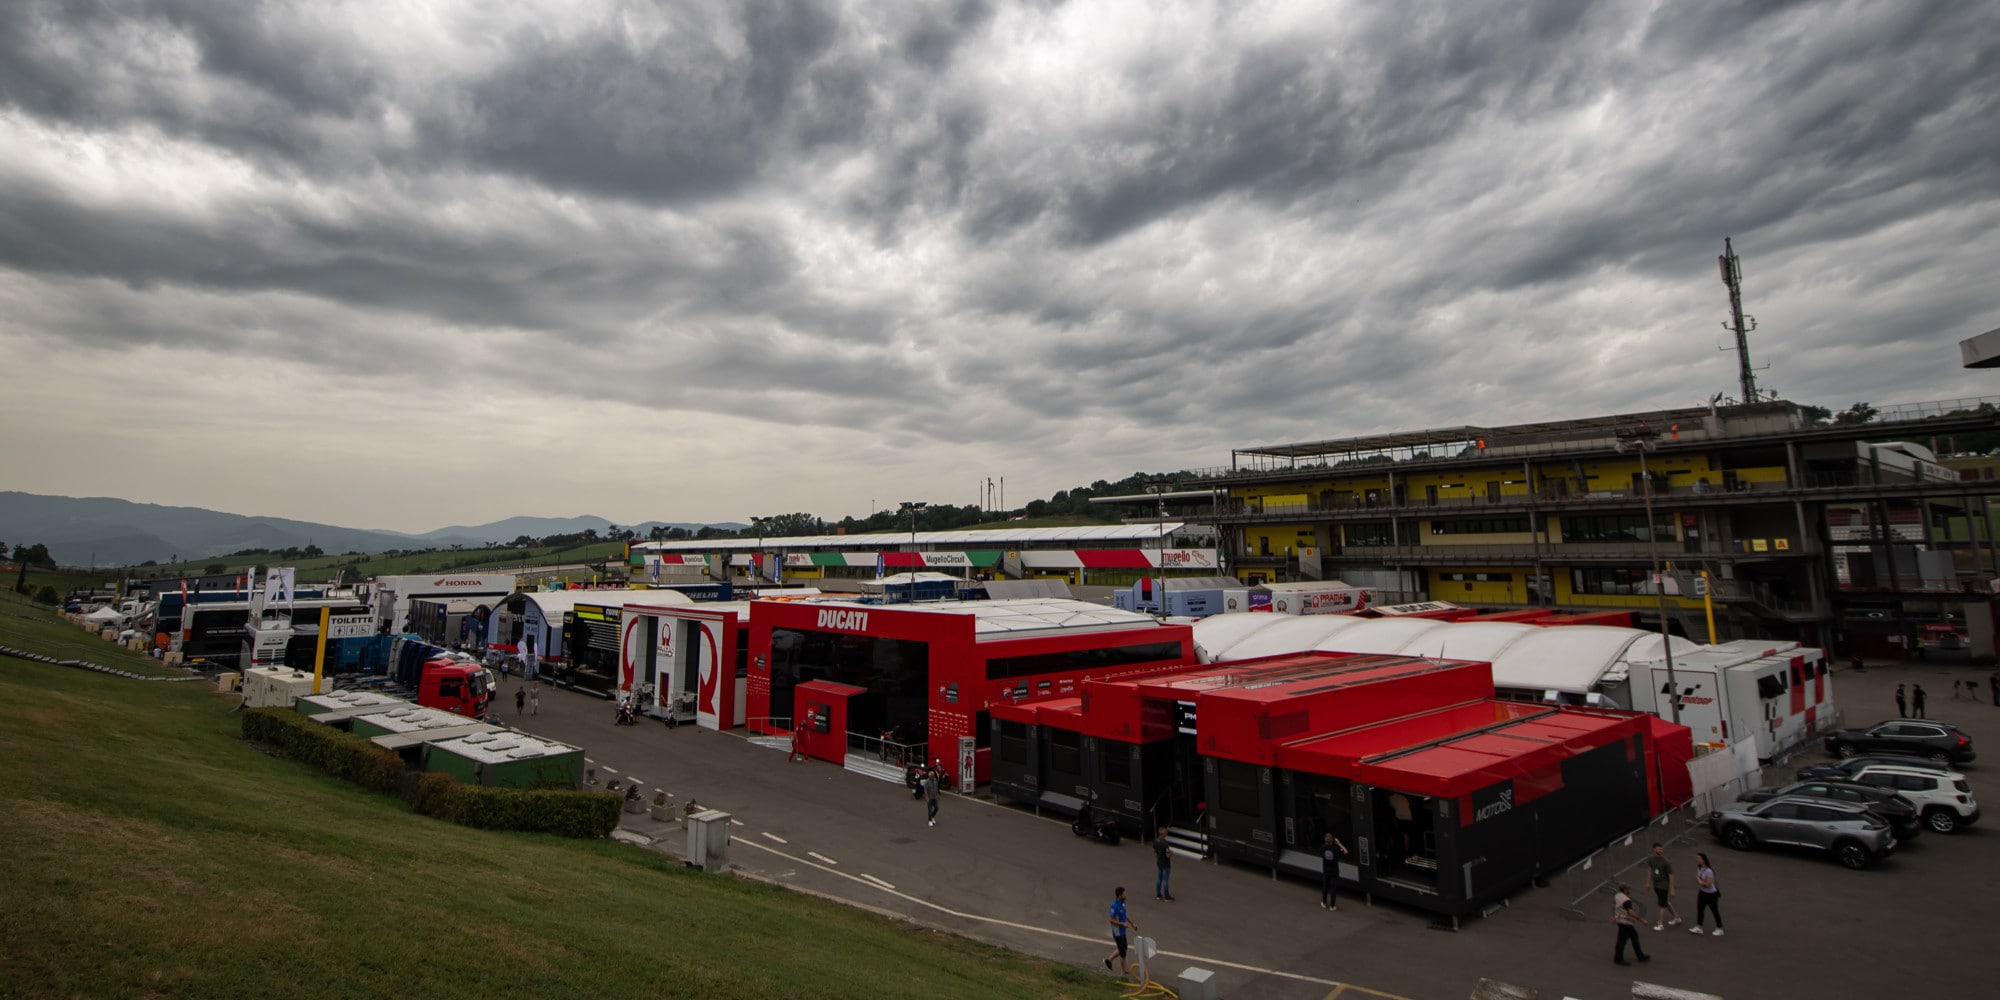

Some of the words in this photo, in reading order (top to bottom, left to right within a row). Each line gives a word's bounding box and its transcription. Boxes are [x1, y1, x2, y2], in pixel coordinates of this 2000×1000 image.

[926, 554, 965, 565] MugelloCircuit
[332, 616, 374, 625] TOILETTE
[817, 608, 869, 632] DUCATI
